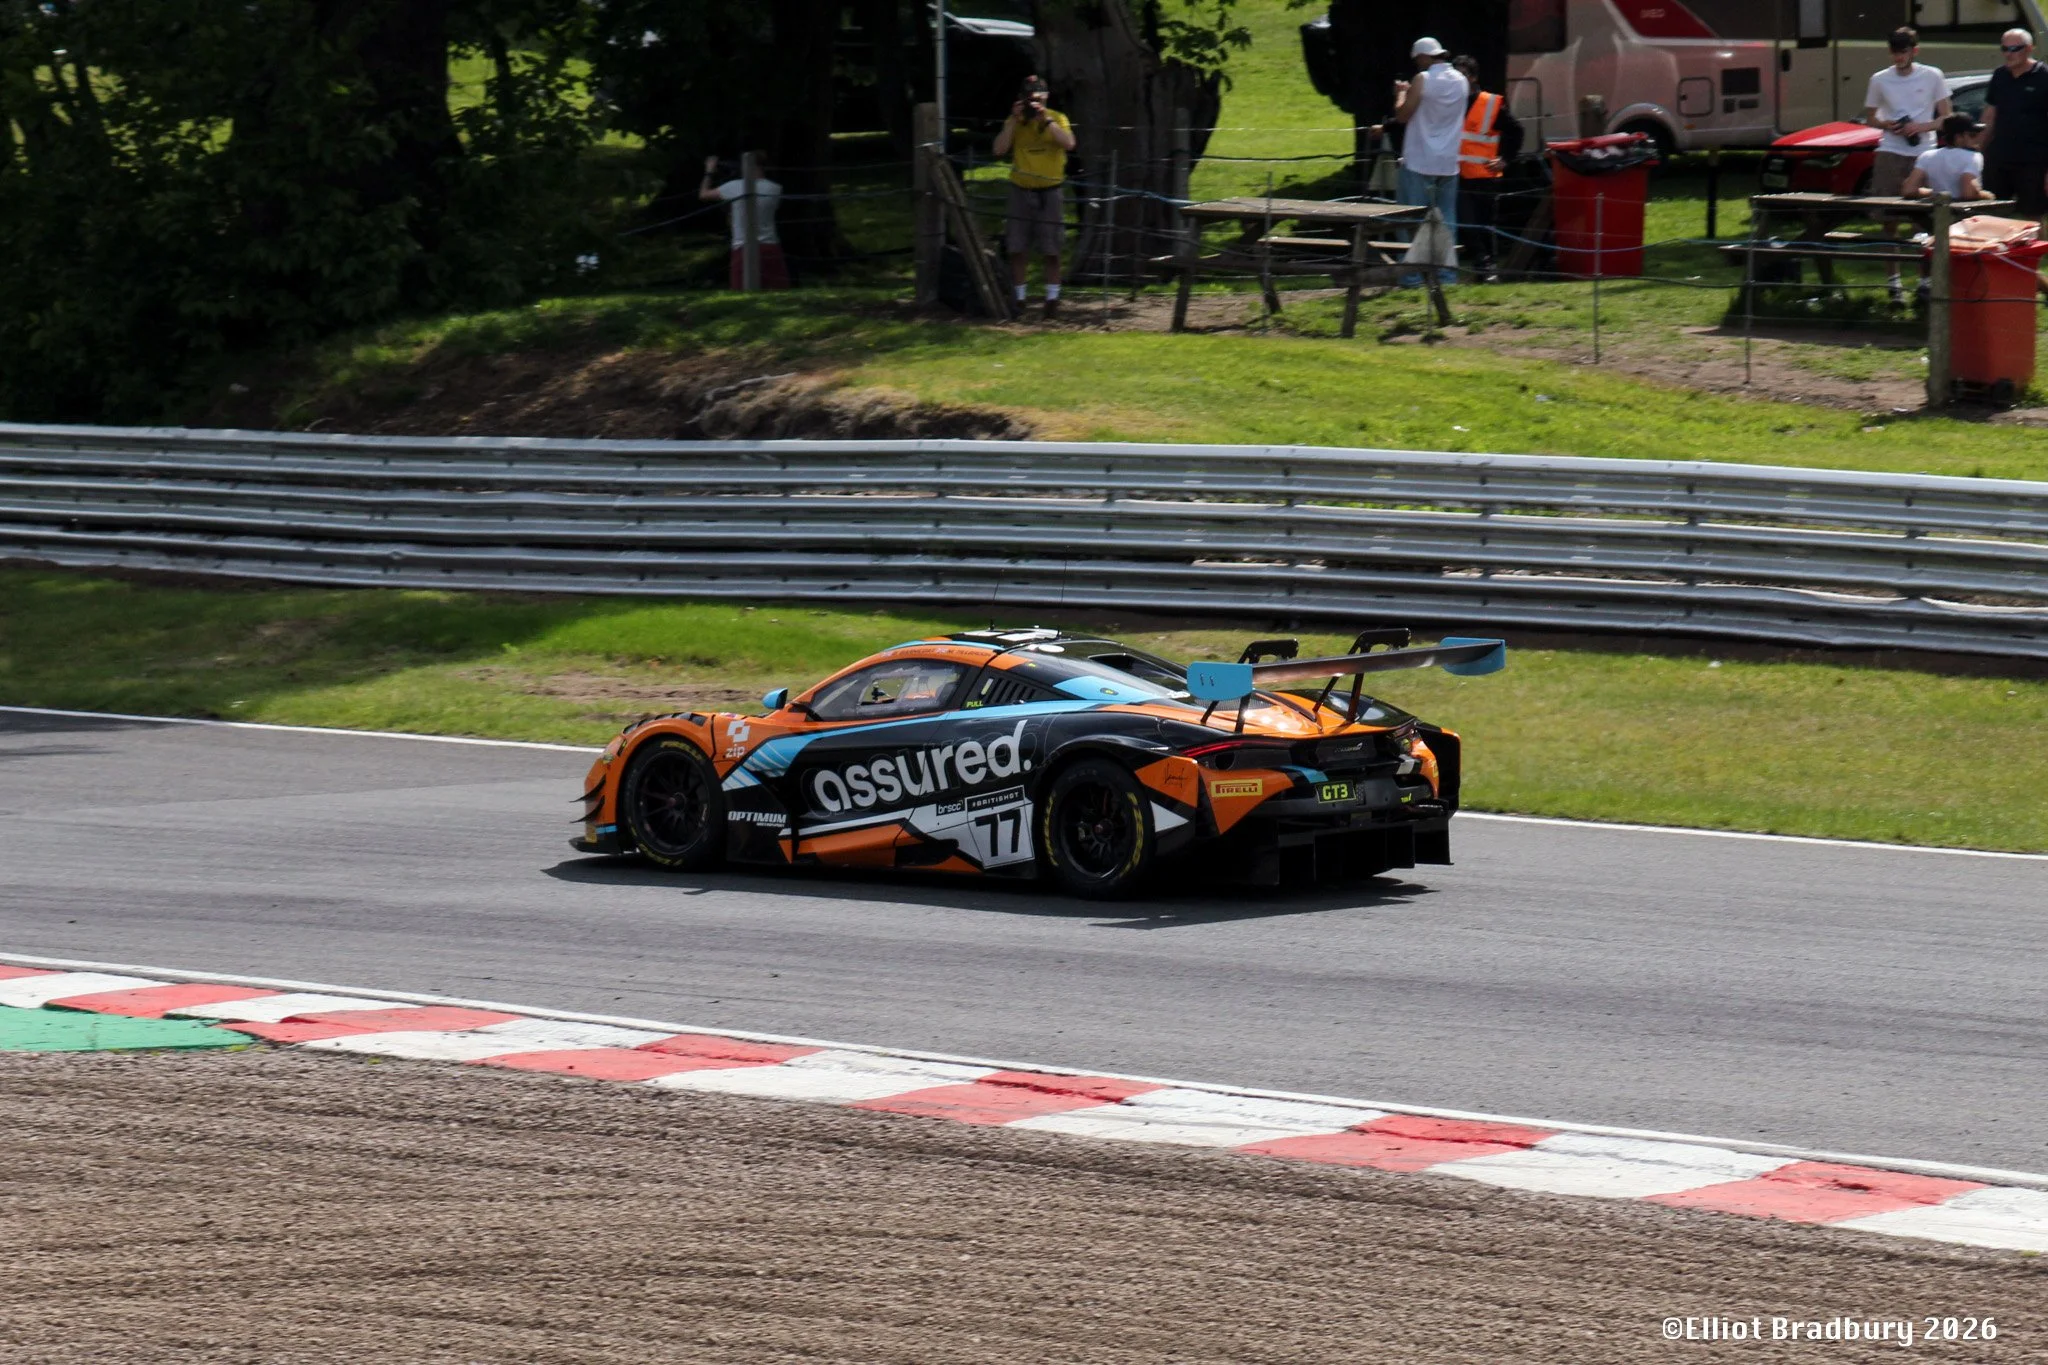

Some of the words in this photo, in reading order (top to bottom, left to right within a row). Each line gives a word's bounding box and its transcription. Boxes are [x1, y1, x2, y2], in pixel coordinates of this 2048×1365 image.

[725, 743, 745, 758] zip
[814, 719, 1033, 812] assured.
[1215, 782, 1258, 794] PIRELLI
[1322, 783, 1349, 800] GT3
[938, 802, 962, 814] brscc
[727, 810, 787, 824] OPTIMUM
[974, 807, 1022, 857] 77
